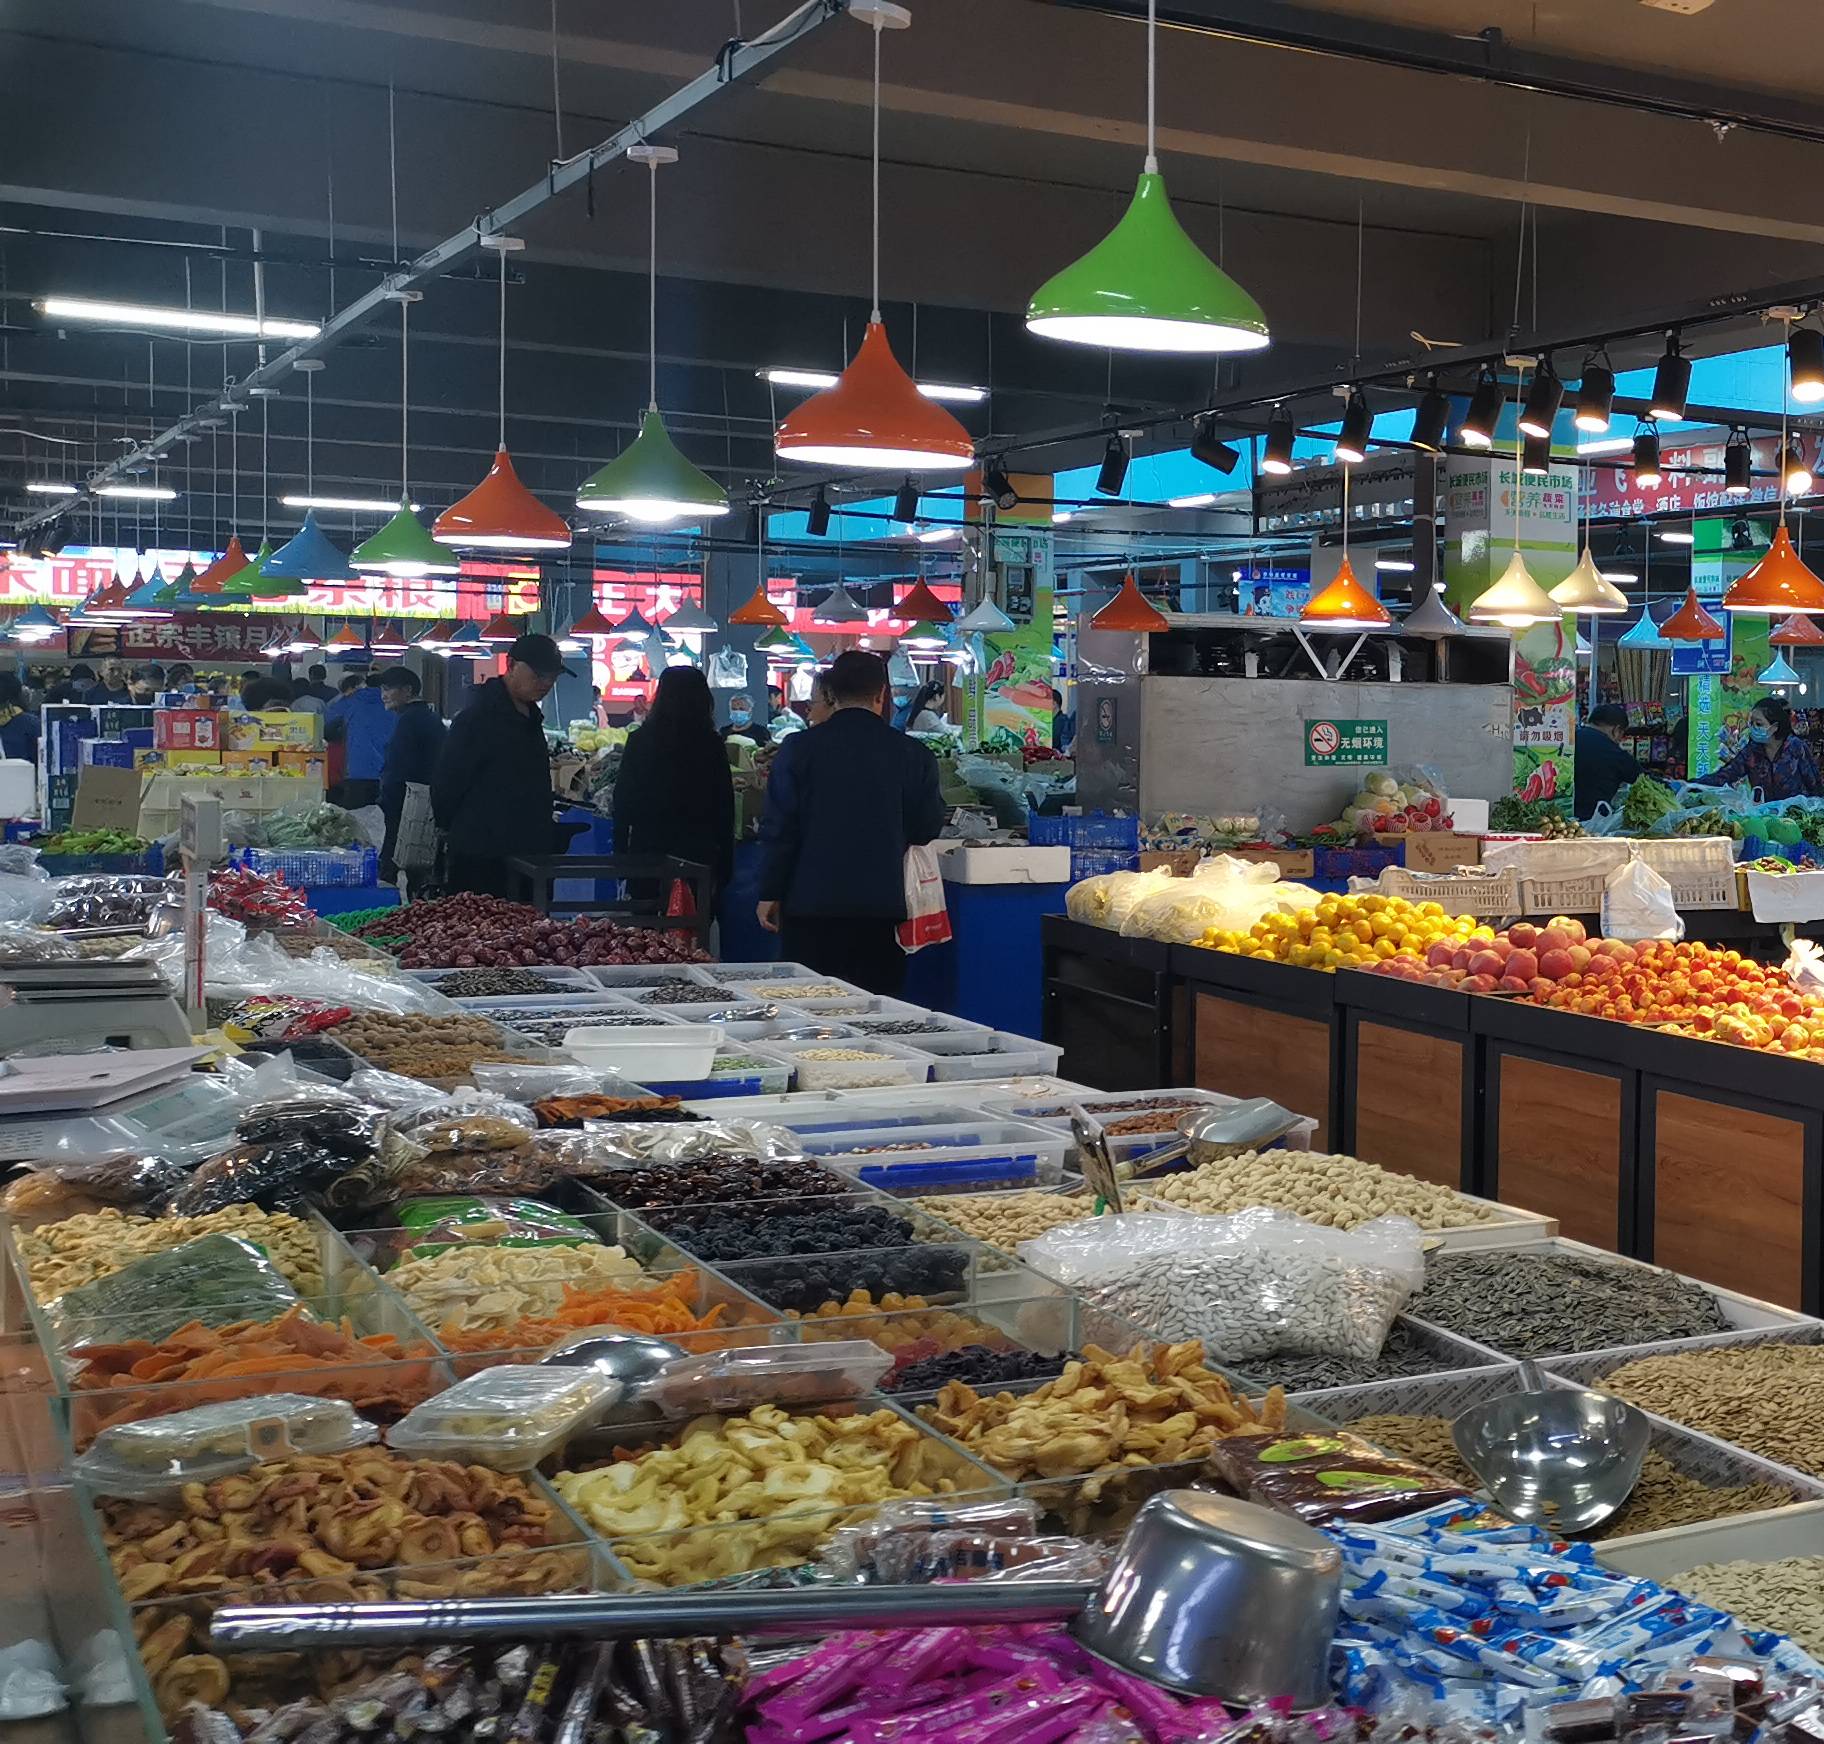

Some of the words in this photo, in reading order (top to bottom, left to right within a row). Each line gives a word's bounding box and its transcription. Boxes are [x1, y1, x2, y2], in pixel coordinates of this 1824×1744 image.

[1498, 470, 1573, 489] 长城便民市场
[127, 621, 292, 652] 正宗丰镇月
[1340, 736, 1384, 750] 无烟环境
[1519, 730, 1564, 742] 请勿吸烟
